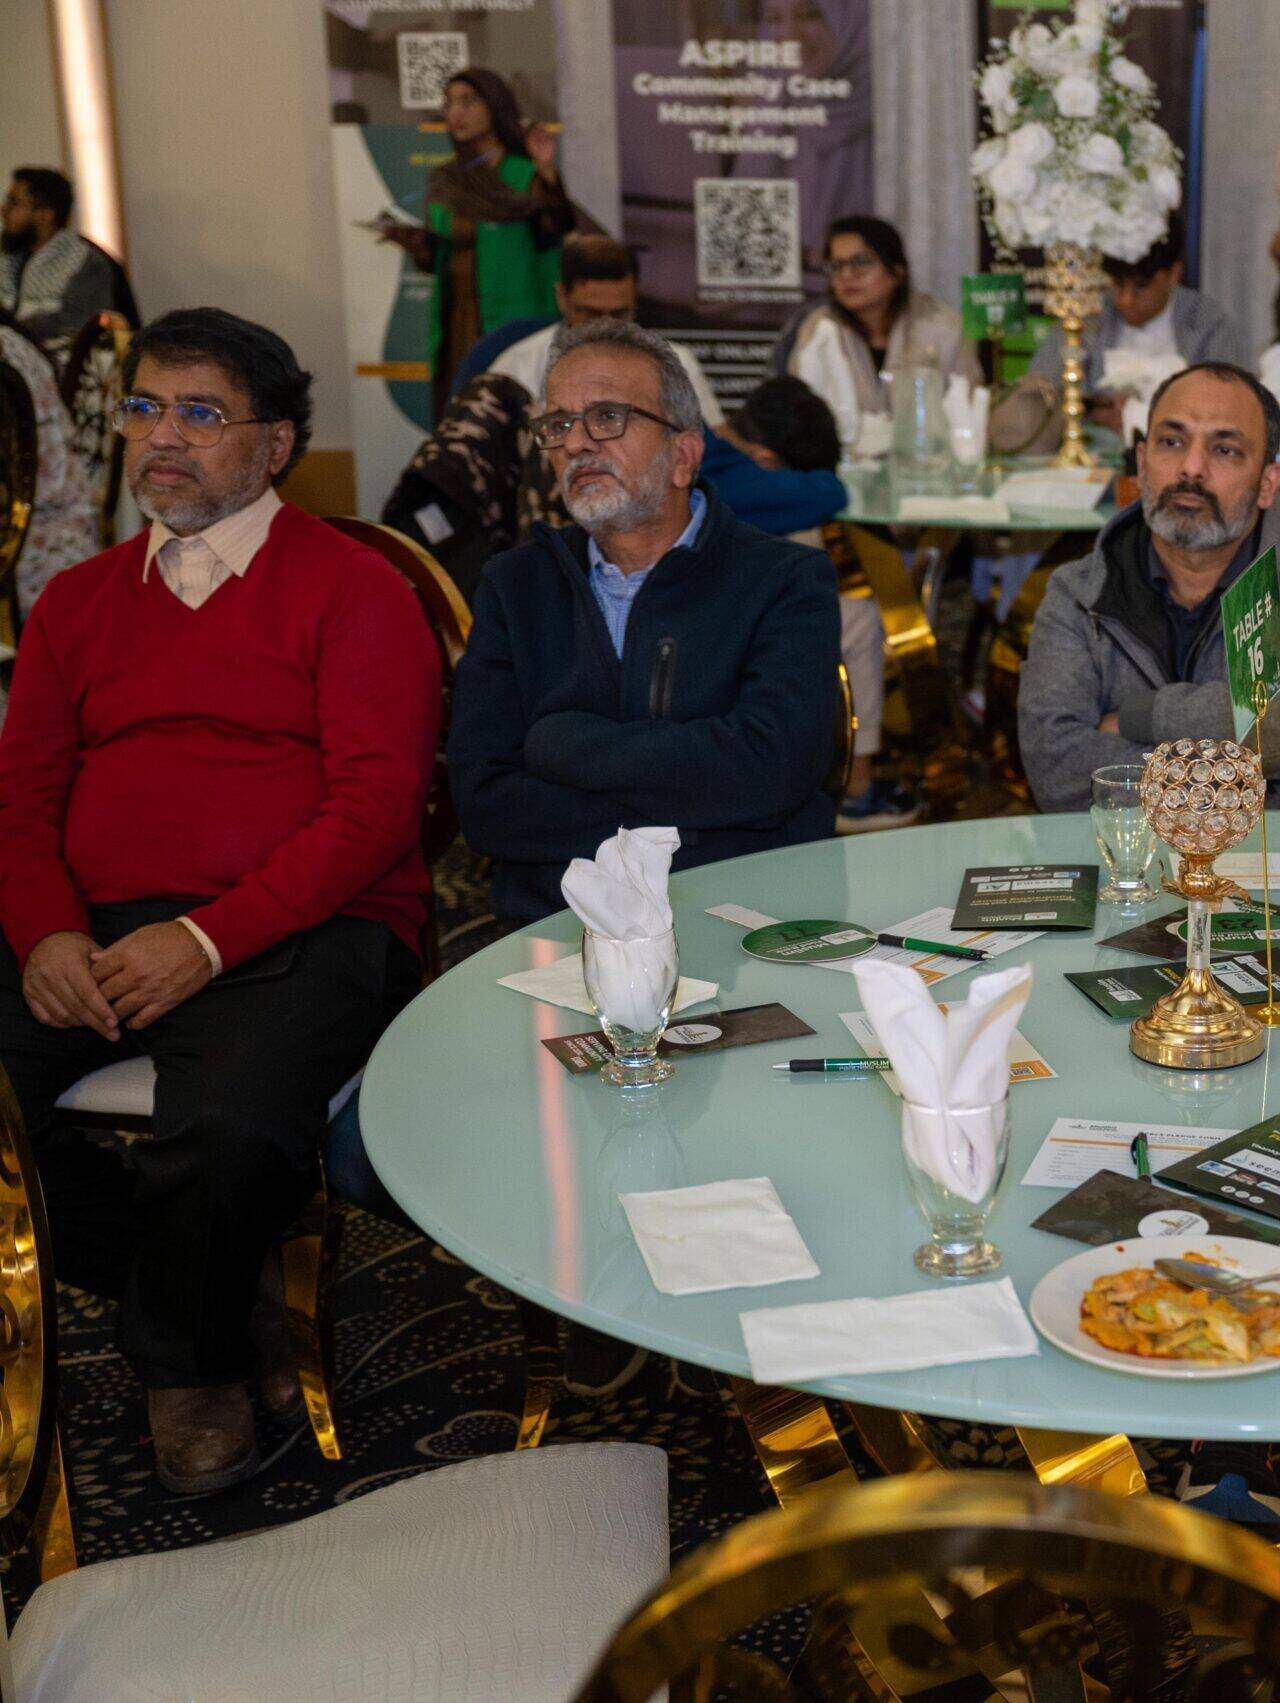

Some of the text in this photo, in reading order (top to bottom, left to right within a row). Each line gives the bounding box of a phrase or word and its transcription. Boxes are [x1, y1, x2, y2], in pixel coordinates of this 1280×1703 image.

[679, 39, 803, 67] ASPIRE
[632, 72, 852, 100] Community Case
[657, 102, 829, 129] Management
[688, 128, 798, 159] Training
[1232, 599, 1264, 652] TABLE
[1247, 636, 1264, 682] 16
